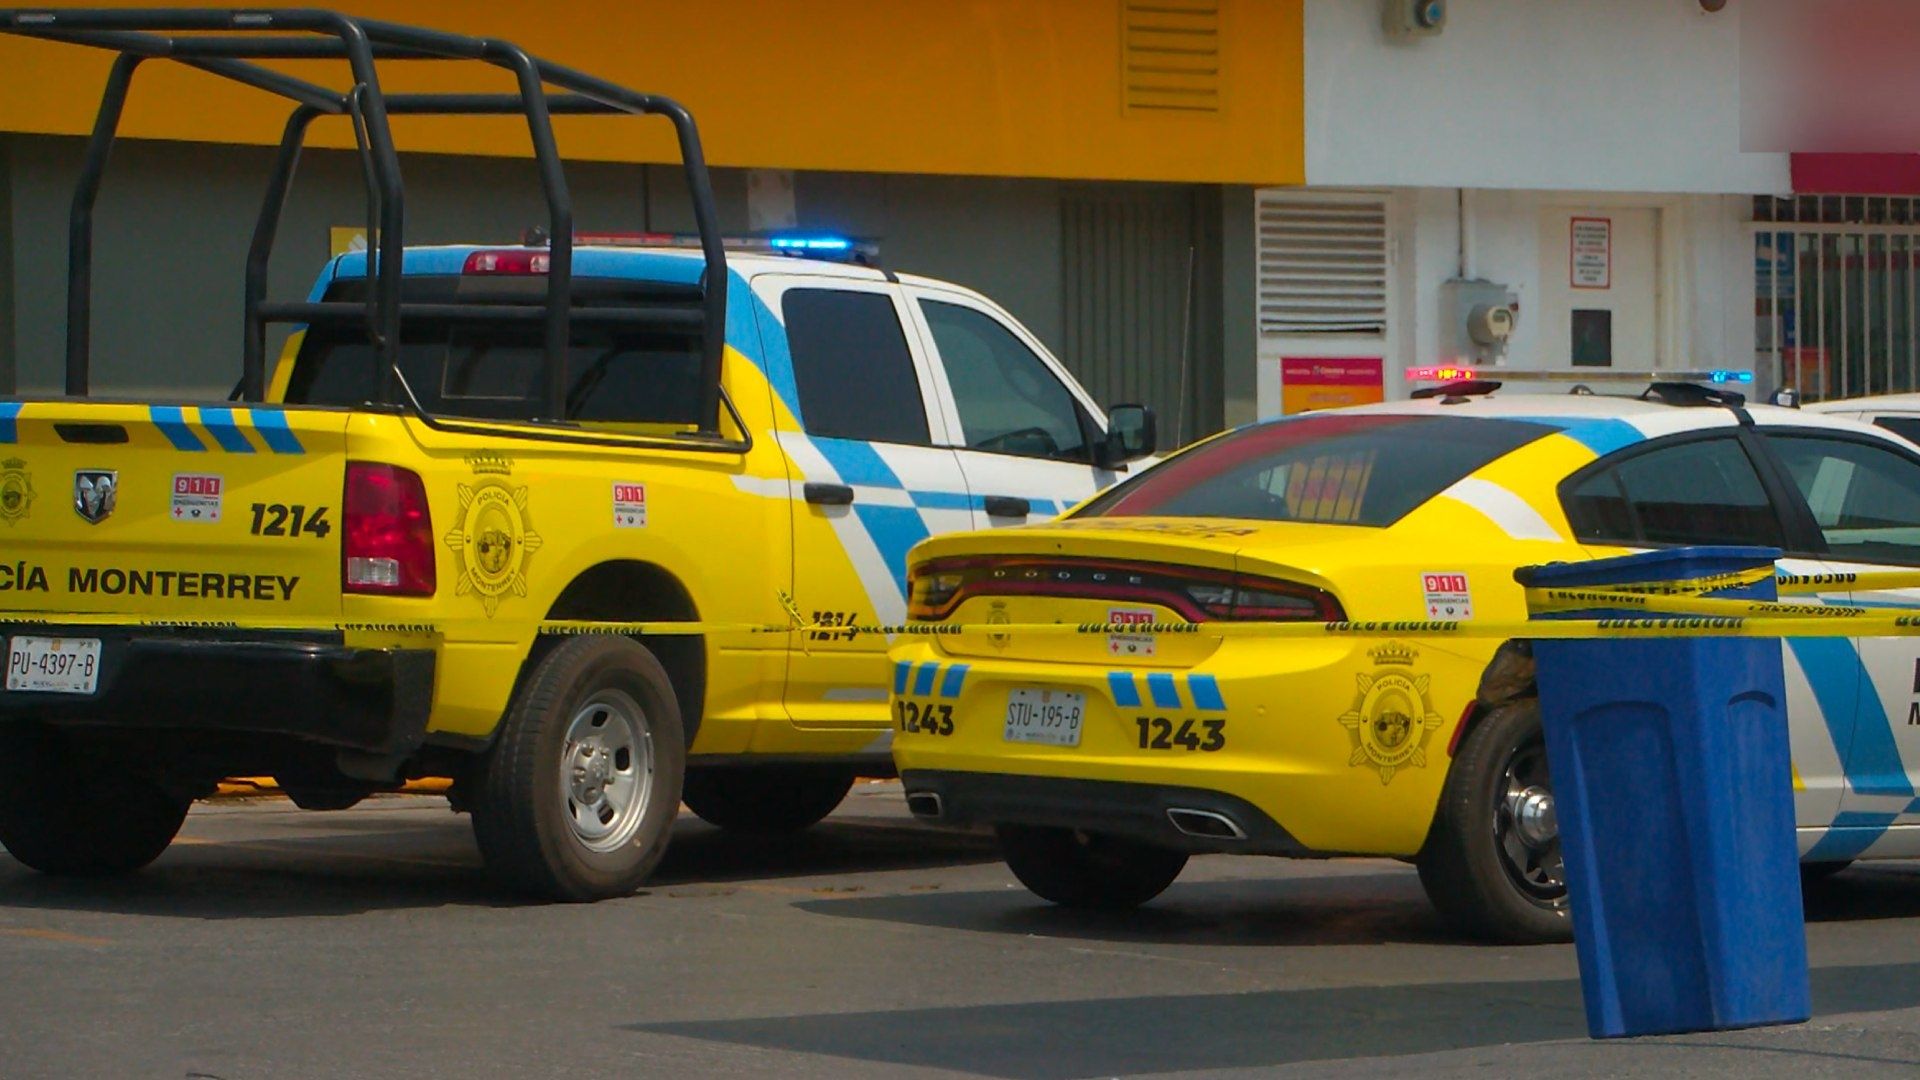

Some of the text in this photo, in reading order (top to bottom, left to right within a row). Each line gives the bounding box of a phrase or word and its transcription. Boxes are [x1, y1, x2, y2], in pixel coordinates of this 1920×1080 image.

[178, 479, 217, 492] 911
[616, 487, 642, 501] 911
[251, 503, 331, 539] 1214
[68, 567, 300, 601] MONTERREY
[994, 569, 1142, 585] DODGE
[1427, 577, 1463, 590] 911
[10, 651, 95, 677] PU-4397-B
[898, 700, 955, 736] 1243
[1007, 702, 1080, 730] STU-195-B
[1136, 717, 1226, 752] 1243
